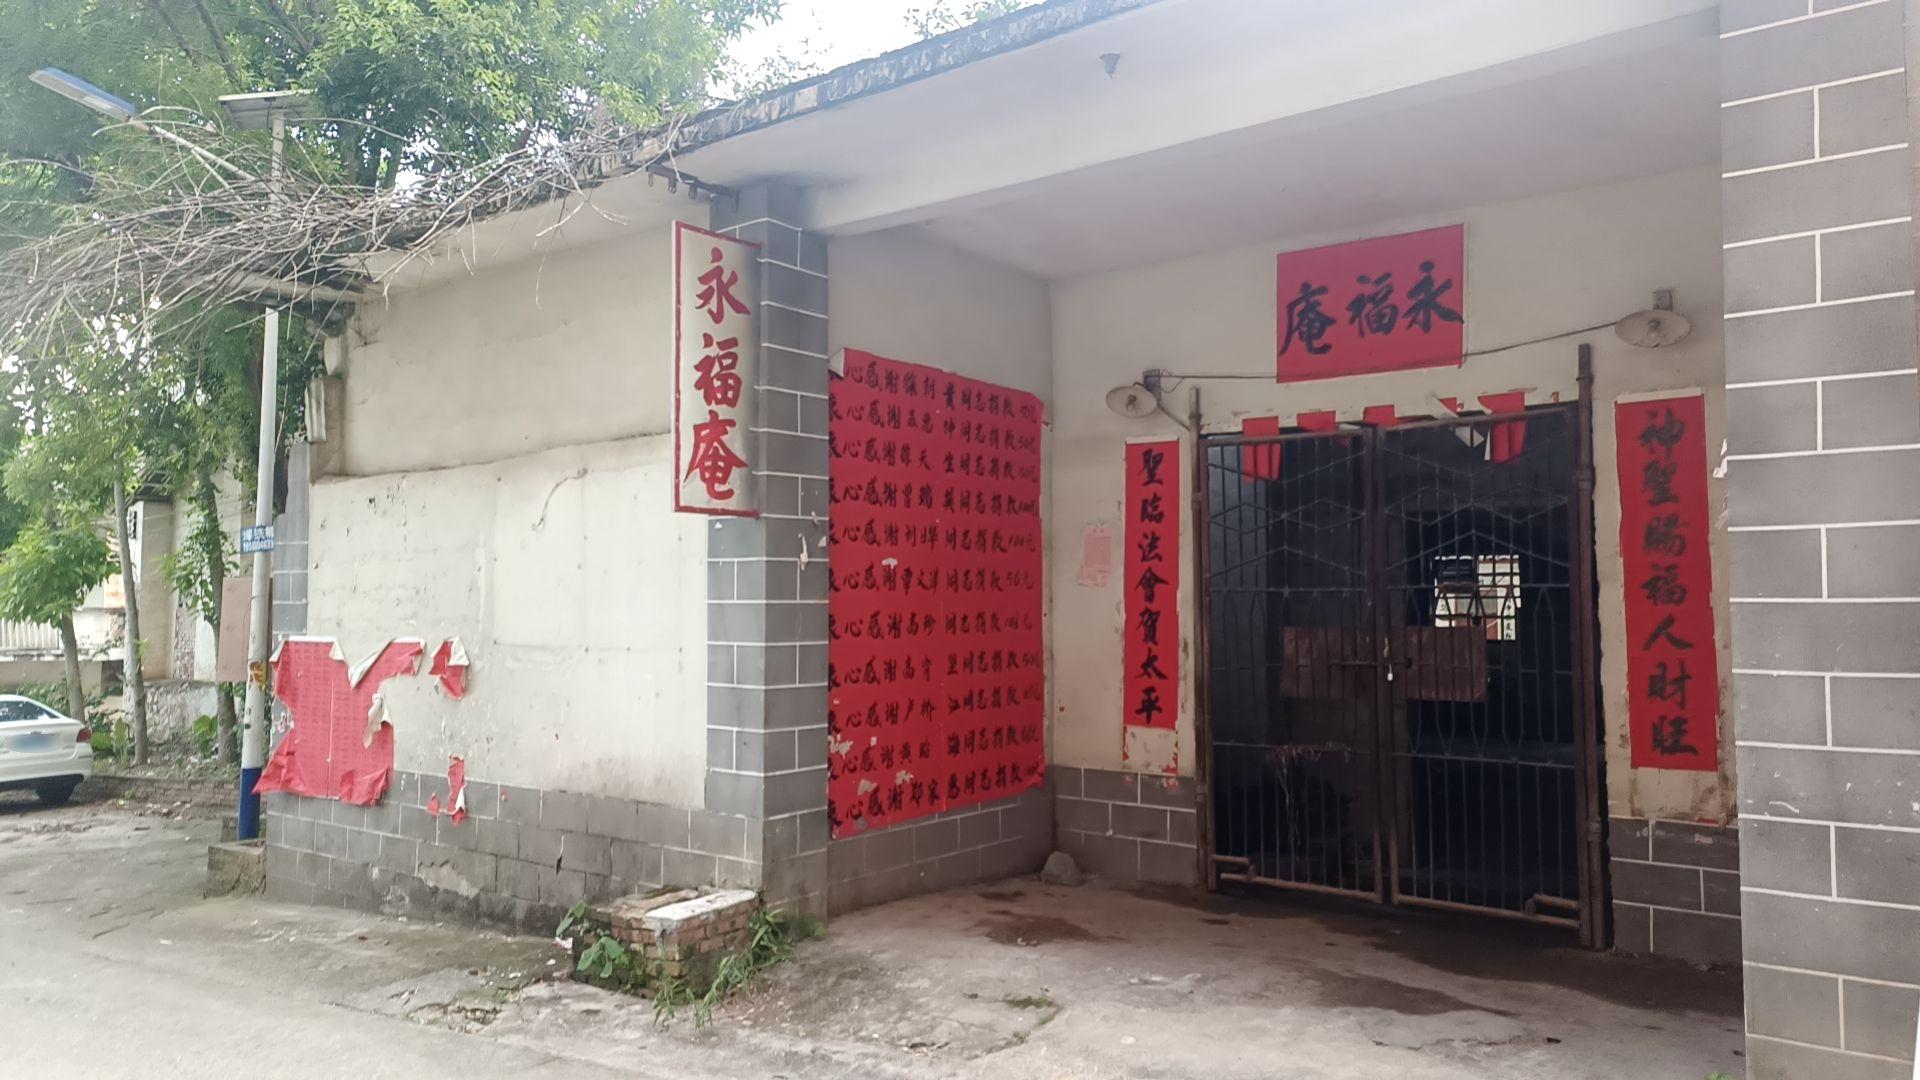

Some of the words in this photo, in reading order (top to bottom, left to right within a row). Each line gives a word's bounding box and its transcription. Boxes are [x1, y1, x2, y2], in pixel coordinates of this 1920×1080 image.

[683, 246, 751, 501] 永福庵
[1277, 260, 1465, 357] 永福庵
[1134, 447, 1169, 725] 聖臨法會賀太平
[1638, 406, 1699, 757] 神聖賜福人財旺
